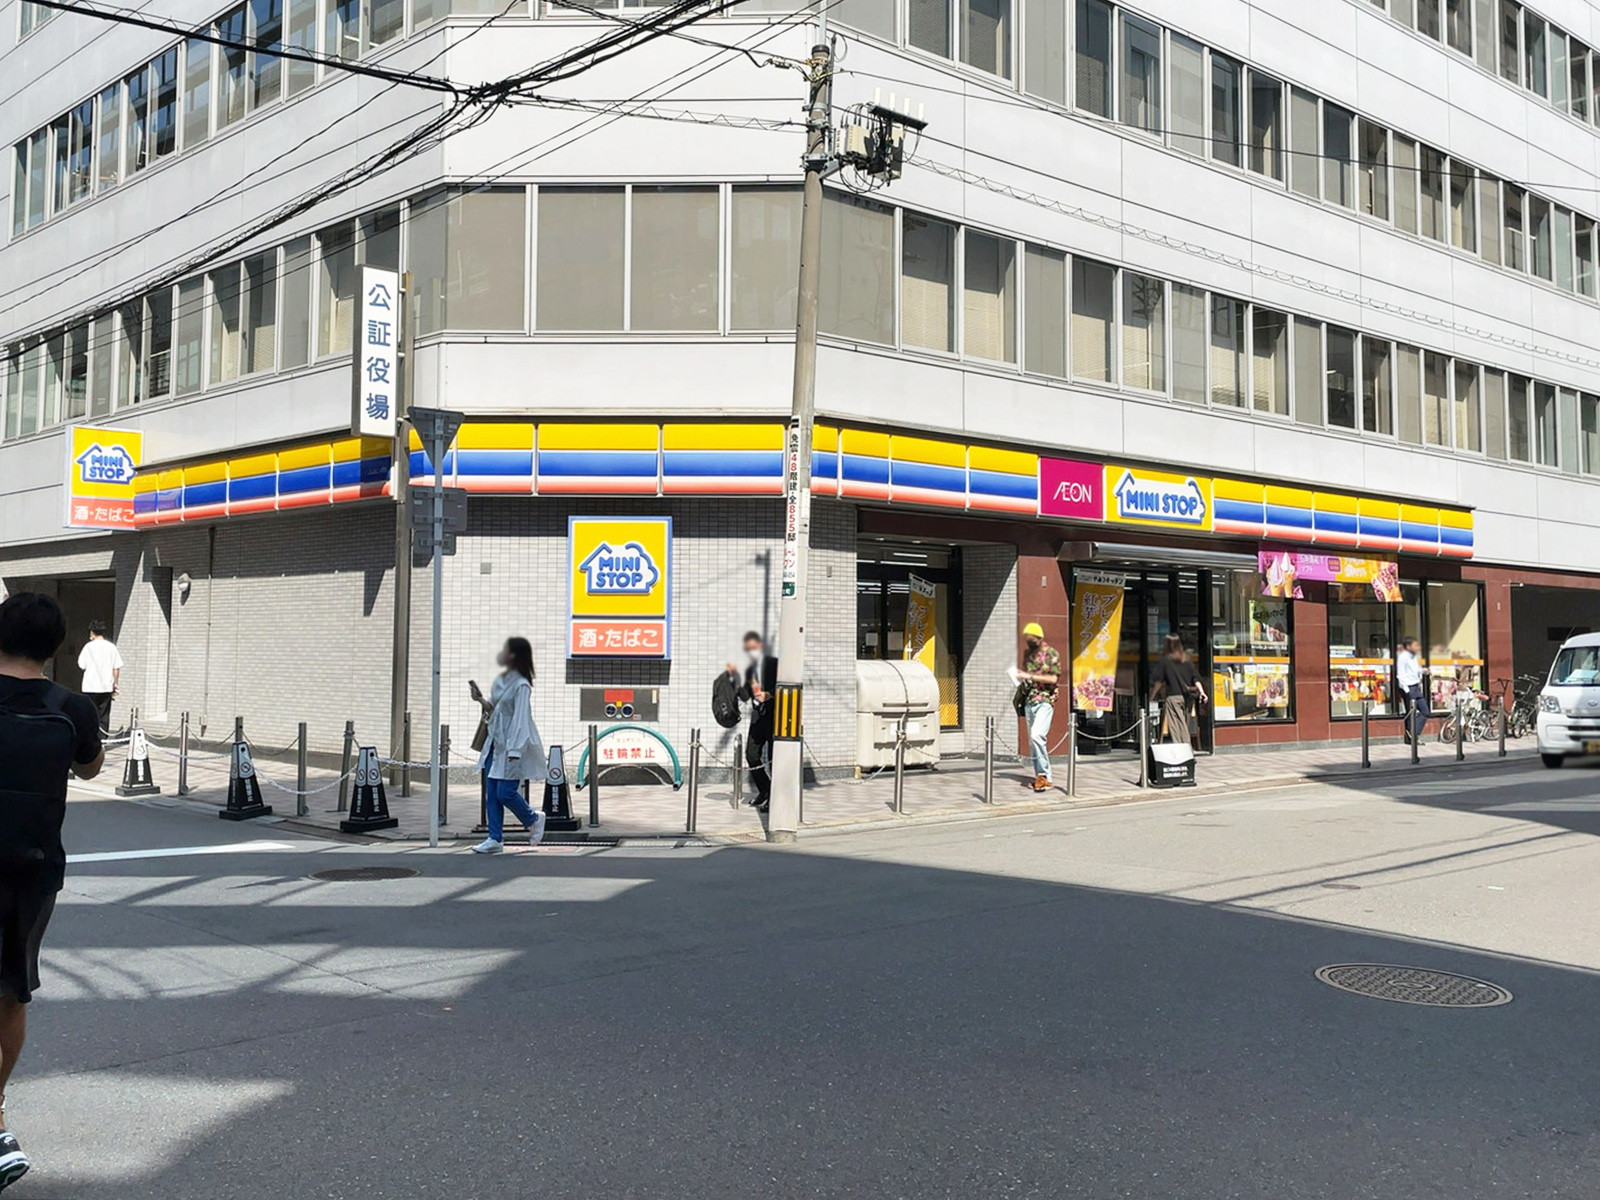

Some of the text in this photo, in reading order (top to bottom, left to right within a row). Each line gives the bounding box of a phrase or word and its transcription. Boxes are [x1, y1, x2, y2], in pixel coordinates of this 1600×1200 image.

[366, 283, 391, 420] 公証役場
[91, 455, 124, 469] MINI
[88, 467, 125, 481] STOP
[1126, 489, 1198, 516] MINI STOP
[599, 556, 641, 571] MINI
[596, 572, 644, 588] STOP
[579, 628, 659, 648] 酒・たばこ
[603, 747, 656, 760] 駐輪禁止
